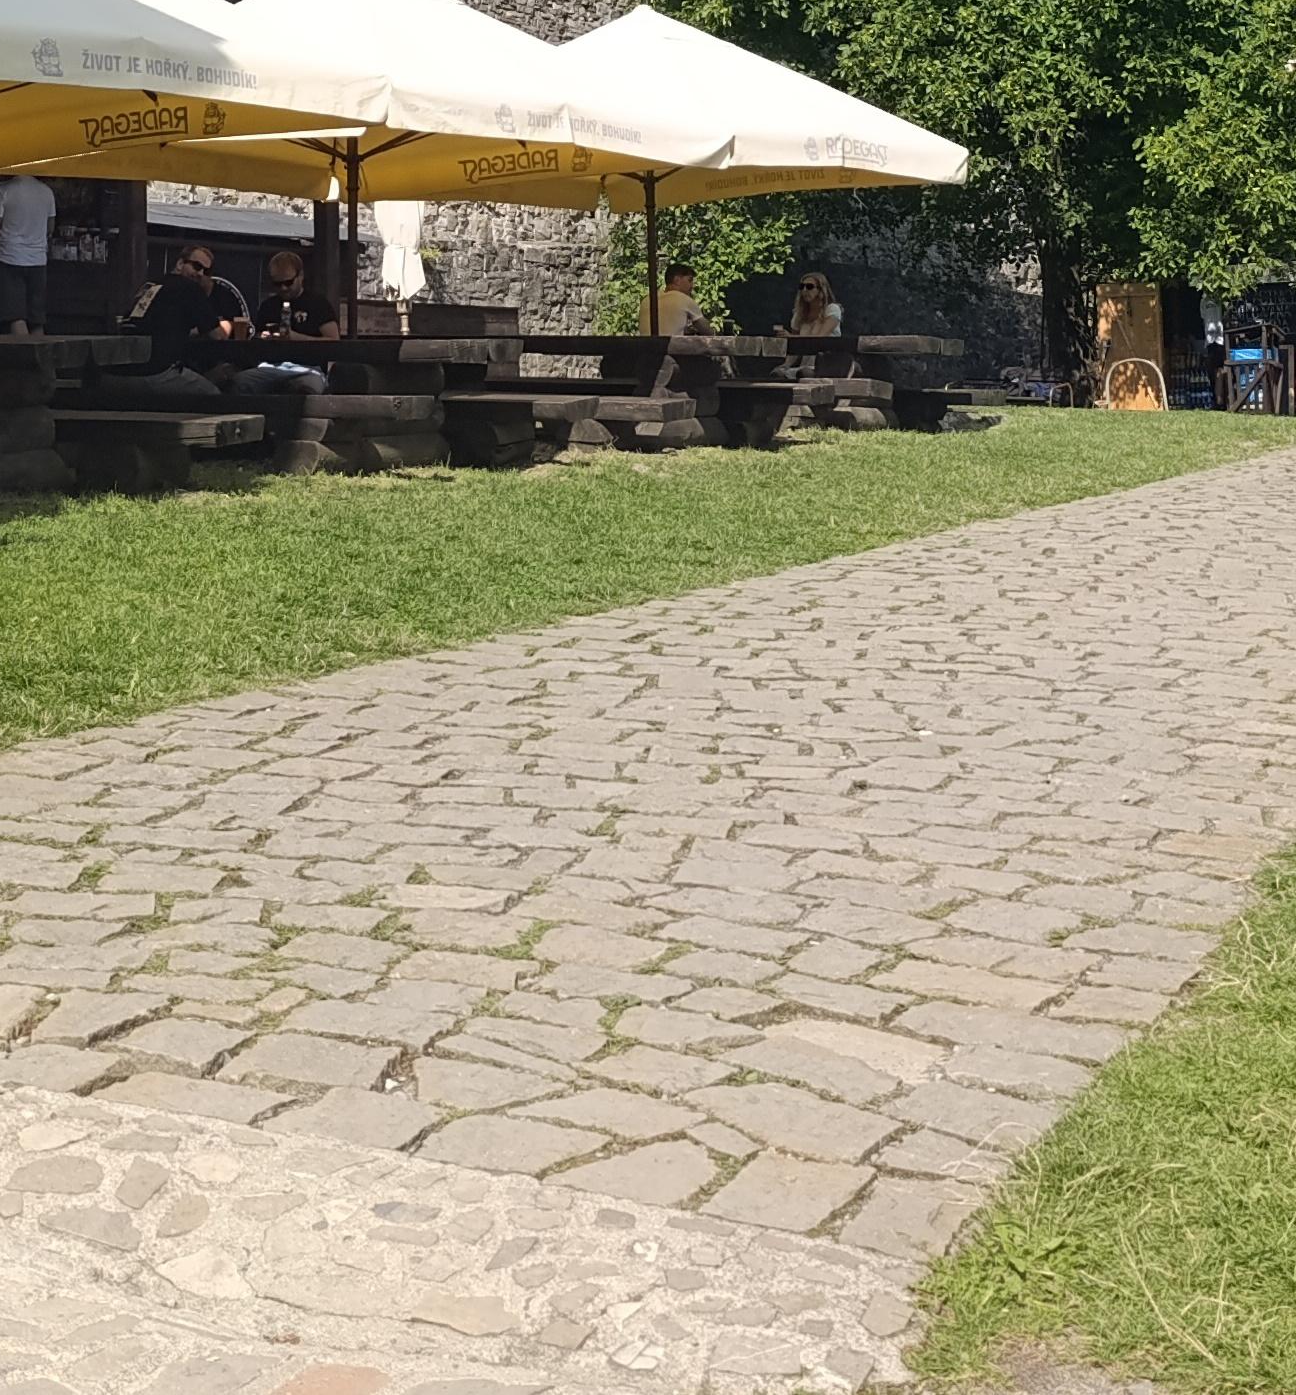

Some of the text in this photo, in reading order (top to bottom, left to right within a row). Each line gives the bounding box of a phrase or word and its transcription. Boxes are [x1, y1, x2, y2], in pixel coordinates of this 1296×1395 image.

[82, 49, 120, 73] ŽIVOT
[126, 56, 142, 74] JE
[197, 67, 257, 90] BOHUDÍK!
[527, 111, 553, 128] ŽIVOT
